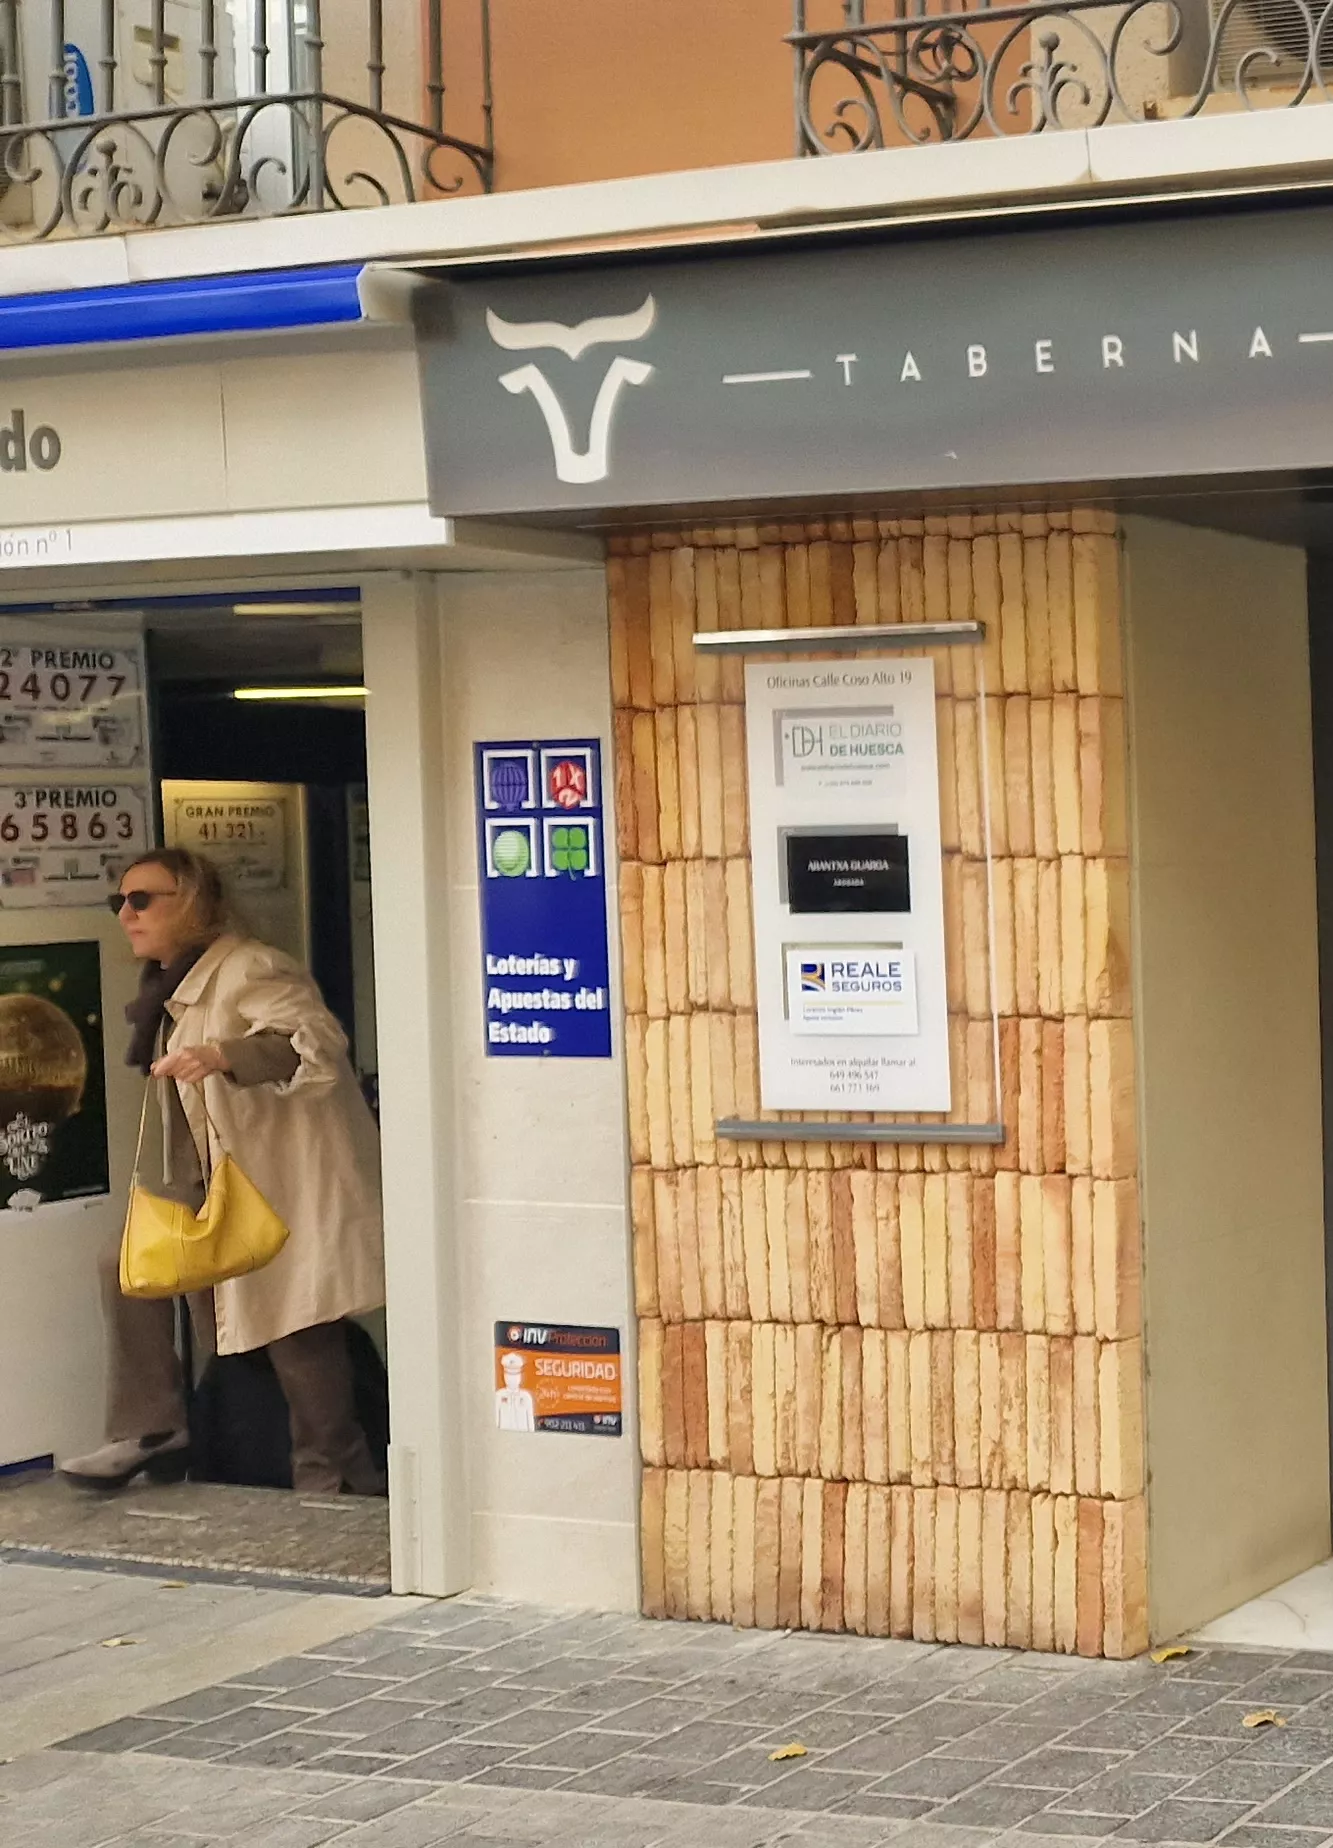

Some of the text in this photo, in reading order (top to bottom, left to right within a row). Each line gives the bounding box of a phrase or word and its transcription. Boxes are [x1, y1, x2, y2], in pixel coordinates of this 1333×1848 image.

[834, 325, 1275, 387] TABERNA
[31, 650, 115, 669] PREMIO
[0, 670, 127, 702] 24077
[766, 670, 912, 690] Oficinas Calle Coso Alto 19
[828, 723, 902, 740] EL DIARIO
[830, 743, 905, 757] DE HUESCA
[35, 789, 118, 809] PREMIO
[0, 812, 134, 841] 65863
[486, 953, 578, 981] Loterías y
[831, 962, 902, 978] REALE
[832, 980, 902, 992] SEGUROS
[488, 986, 607, 1014] Apuestas del
[488, 1020, 556, 1044] Estado
[534, 1358, 618, 1381] SEGURIDAD
